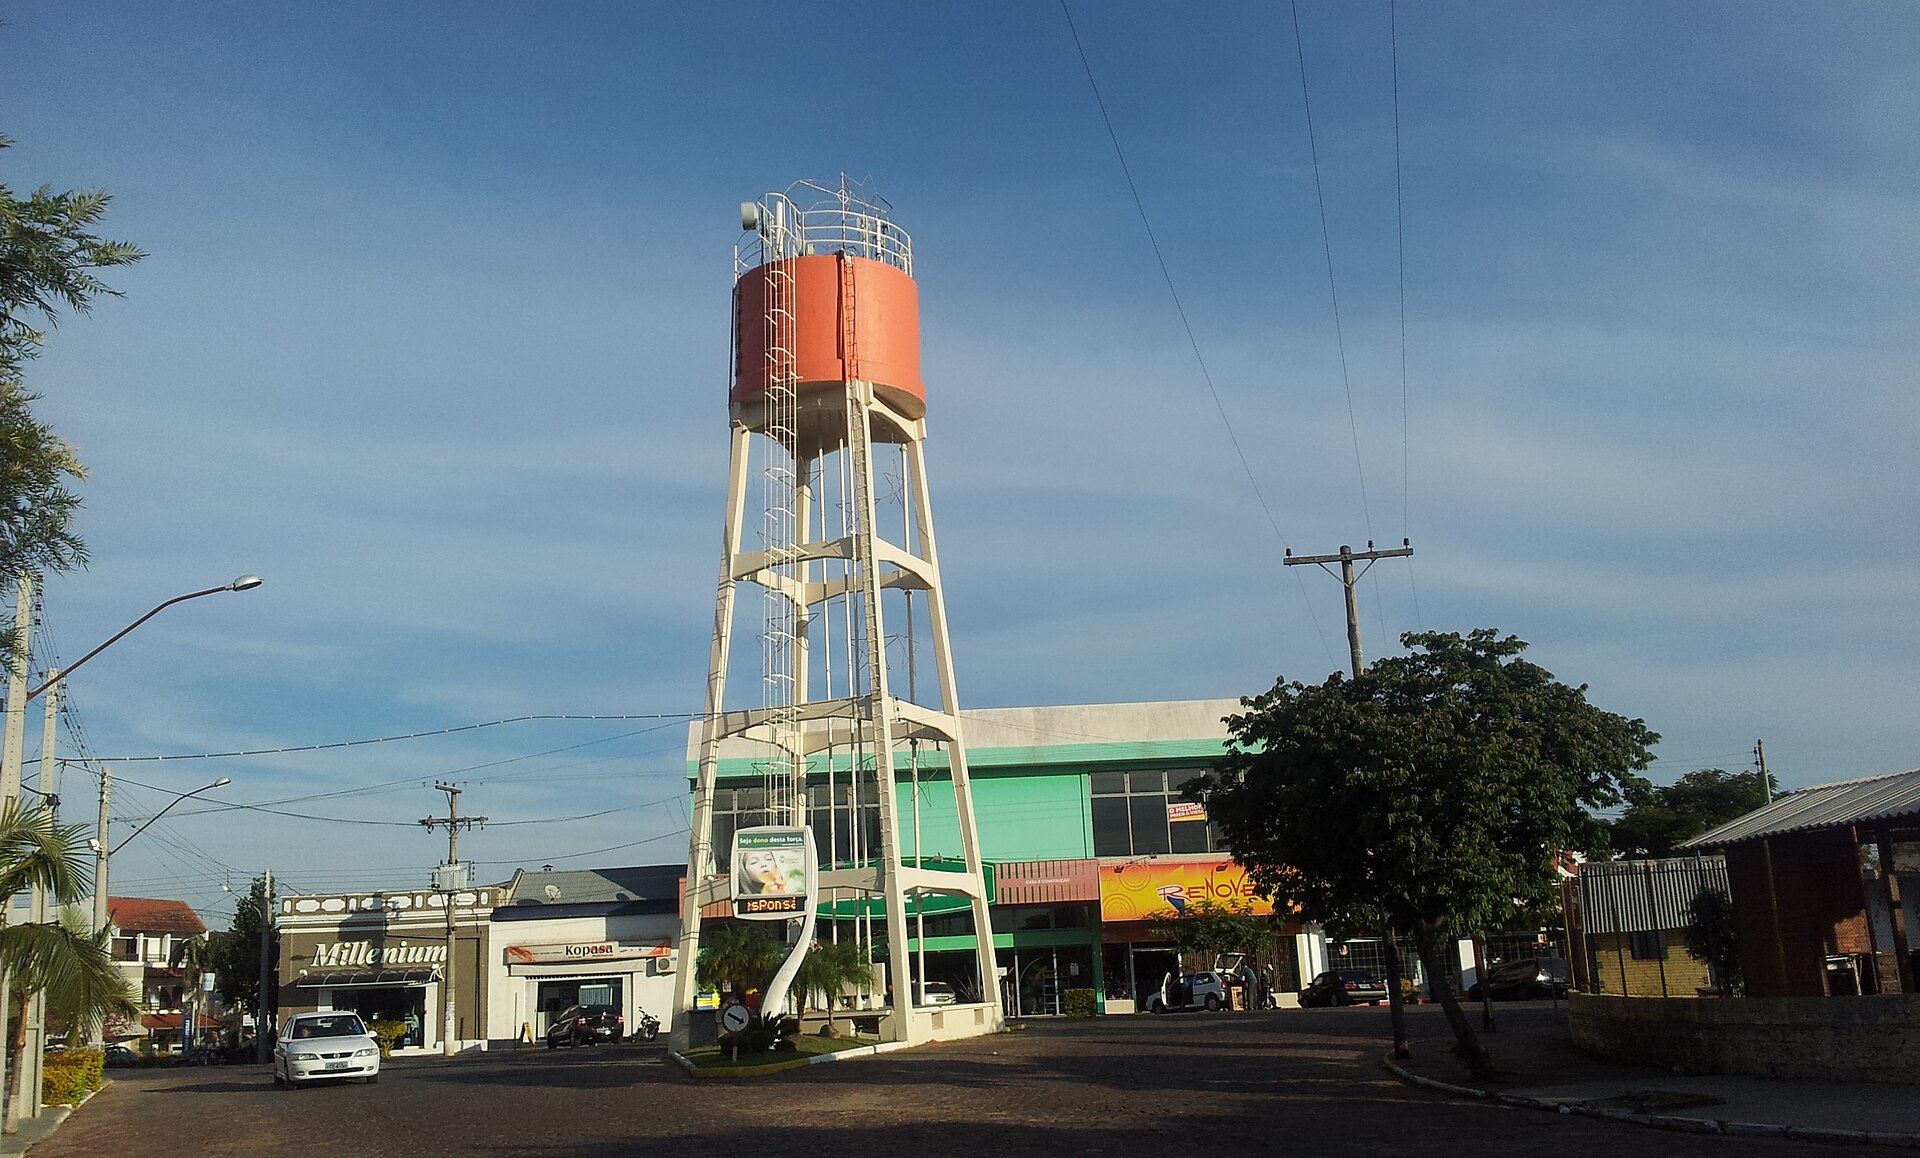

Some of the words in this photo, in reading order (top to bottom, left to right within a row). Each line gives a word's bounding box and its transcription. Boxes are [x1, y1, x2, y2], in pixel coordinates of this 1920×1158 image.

[739, 837, 752, 845] Seja
[310, 940, 447, 968] Millenium
[565, 944, 613, 957] Kopasa
